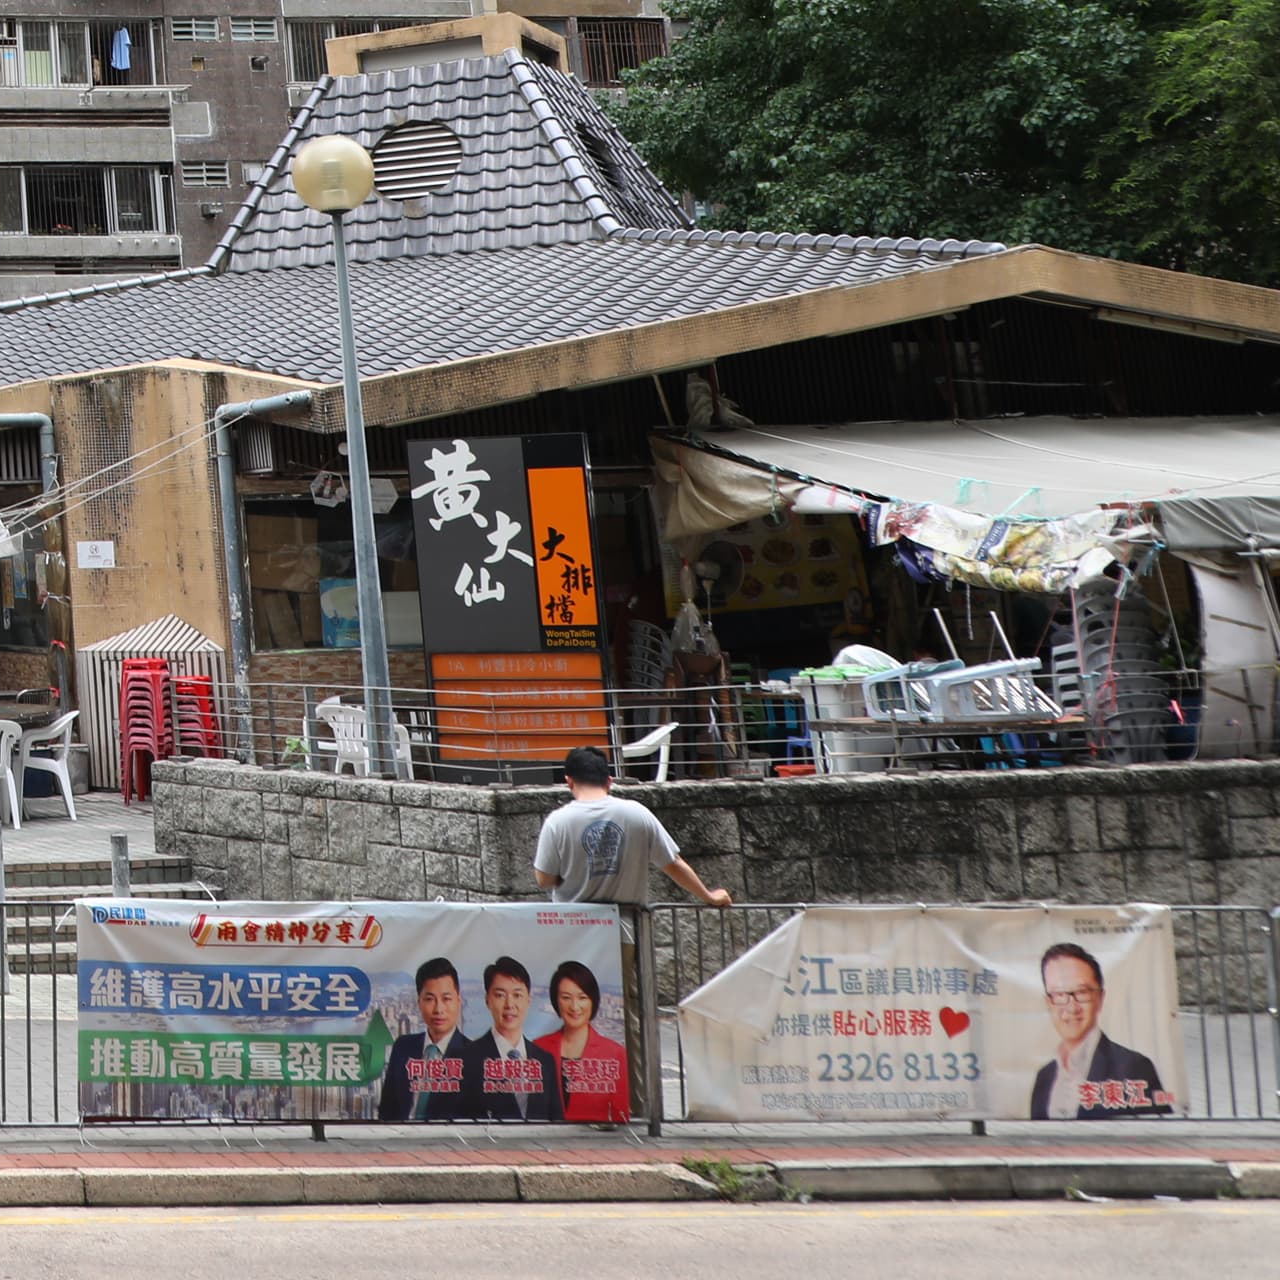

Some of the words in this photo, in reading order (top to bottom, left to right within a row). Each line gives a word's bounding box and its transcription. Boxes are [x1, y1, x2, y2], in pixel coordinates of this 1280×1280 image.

[411, 439, 534, 607] 黃大仙
[540, 527, 593, 624] 大排檔
[545, 630, 596, 639] WongTaiSin
[546, 639, 597, 648] DaPaiDong
[110, 907, 146, 920] 民建聯
[216, 919, 356, 943] 兩會精神分享
[90, 967, 360, 1012] 維護高水平安全
[90, 1038, 362, 1081] 推動高質量發展
[406, 1058, 464, 1080] 何俊賢
[483, 1058, 544, 1080] 越毅強
[817, 1052, 894, 1082] 2326
[903, 1051, 981, 1081] 8133
[409, 1080, 461, 1093] 立法會議員
[566, 1081, 618, 1094] 立法會議員
[1078, 1079, 1153, 1110] 李東江
